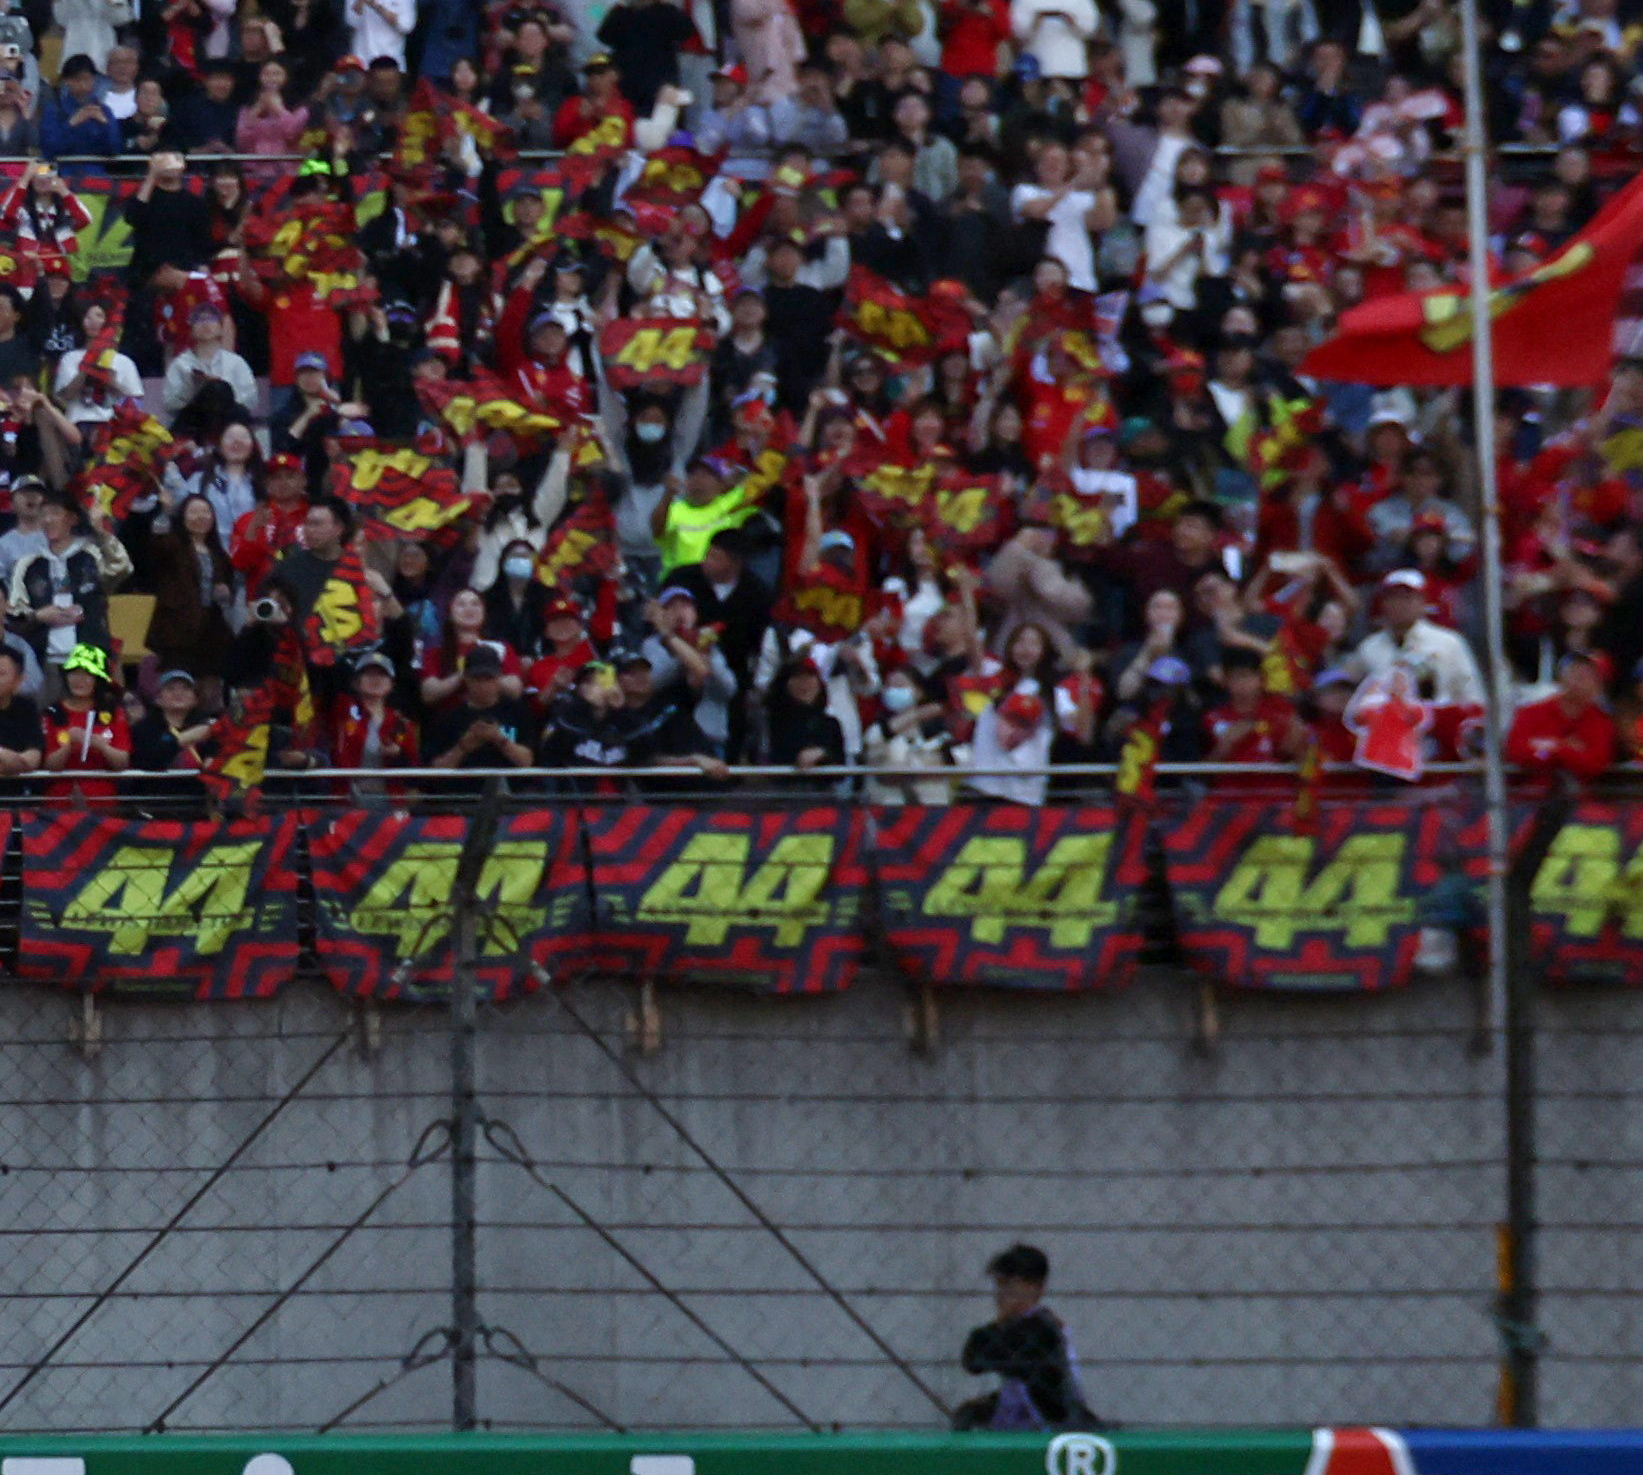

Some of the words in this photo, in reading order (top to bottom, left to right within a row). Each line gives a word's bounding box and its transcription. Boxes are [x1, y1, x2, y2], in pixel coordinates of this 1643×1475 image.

[617, 326, 697, 372] 44
[60, 840, 264, 956] 44
[636, 832, 835, 947] 44
[921, 833, 1118, 949] 44
[1213, 832, 1419, 949] 44
